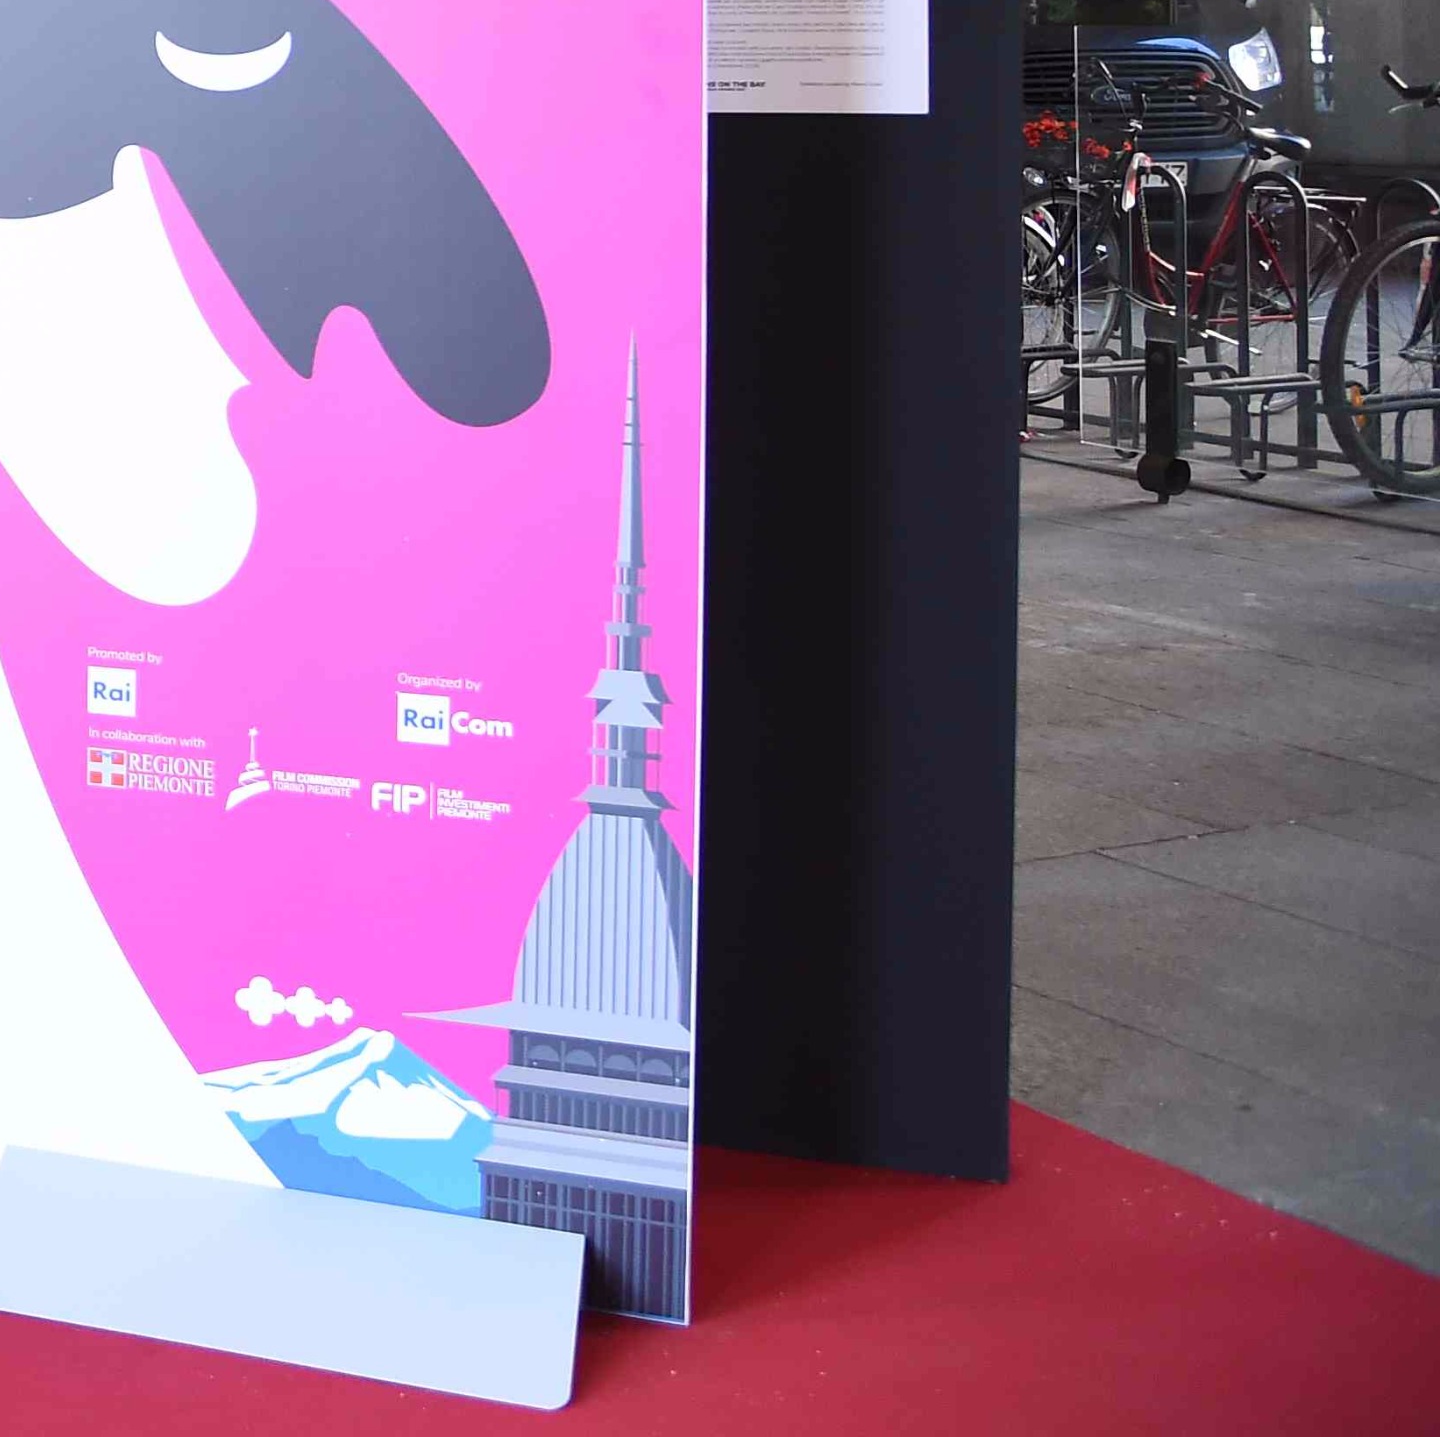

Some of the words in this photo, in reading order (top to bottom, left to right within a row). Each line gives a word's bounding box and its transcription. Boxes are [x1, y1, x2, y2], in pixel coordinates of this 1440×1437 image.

[87, 646, 145, 663] Promoted
[147, 651, 163, 665] by
[93, 681, 131, 702] Rai
[397, 672, 462, 689] Organized
[465, 679, 482, 692] by
[404, 709, 443, 730] Rai
[451, 711, 514, 737] Com
[88, 726, 100, 738] In
[102, 728, 176, 746] collaboration
[180, 737, 206, 749] with
[129, 752, 216, 780] REGIONE
[128, 773, 216, 798] PIEMONTE
[272, 770, 296, 783] FILM
[297, 772, 361, 790] COMMISSION
[306, 784, 352, 799] PIEMONTE
[371, 781, 427, 814] FIP
[437, 788, 464, 800] FILM
[437, 807, 493, 822] PIEMONTE
